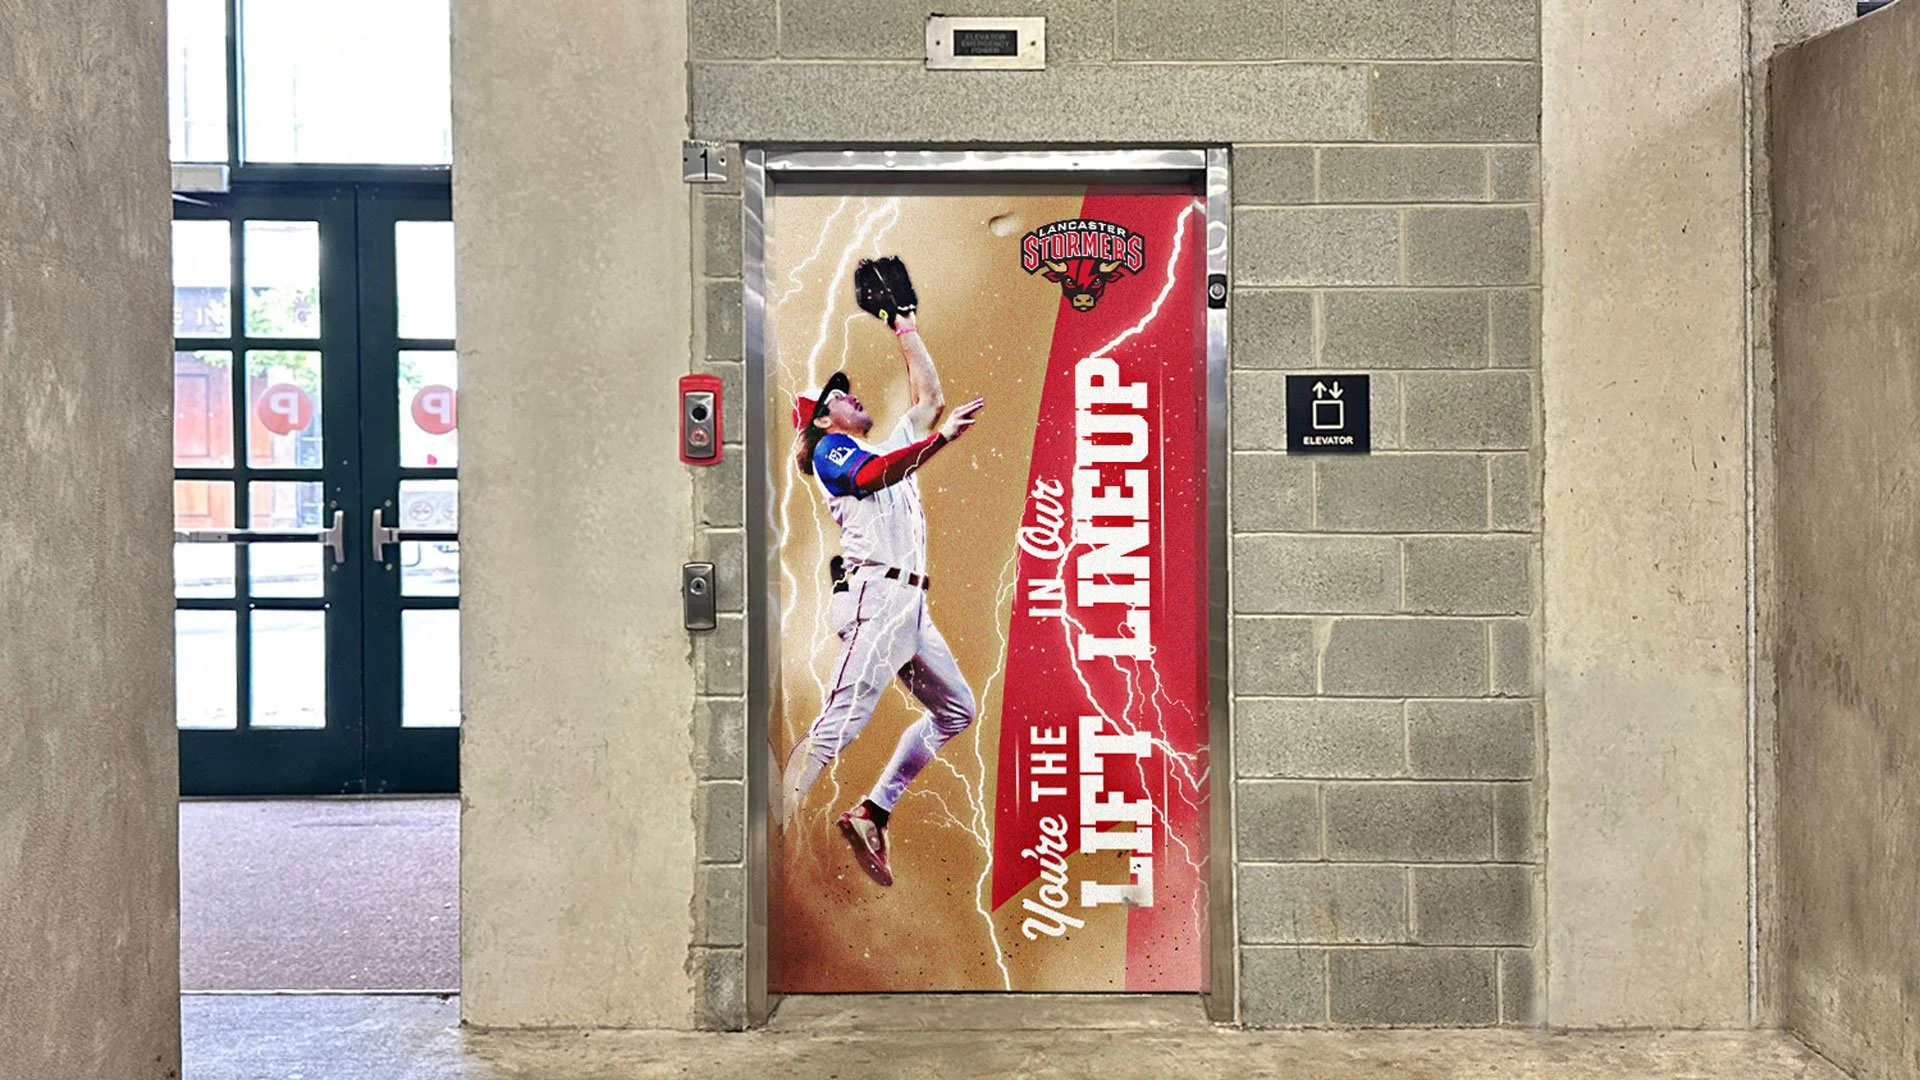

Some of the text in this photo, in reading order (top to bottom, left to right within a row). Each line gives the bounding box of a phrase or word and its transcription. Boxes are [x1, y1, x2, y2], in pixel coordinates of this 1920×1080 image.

[700, 148, 708, 180] 1
[1023, 231, 1142, 271] STORMERS
[1038, 220, 1126, 238] LANCASTER
[1302, 435, 1354, 445] ELEVATOR
[1017, 475, 1067, 617] IN Our
[1074, 357, 1151, 661] LINEUP
[1021, 726, 1085, 941] You're THE
[1078, 715, 1154, 908] LIFT
